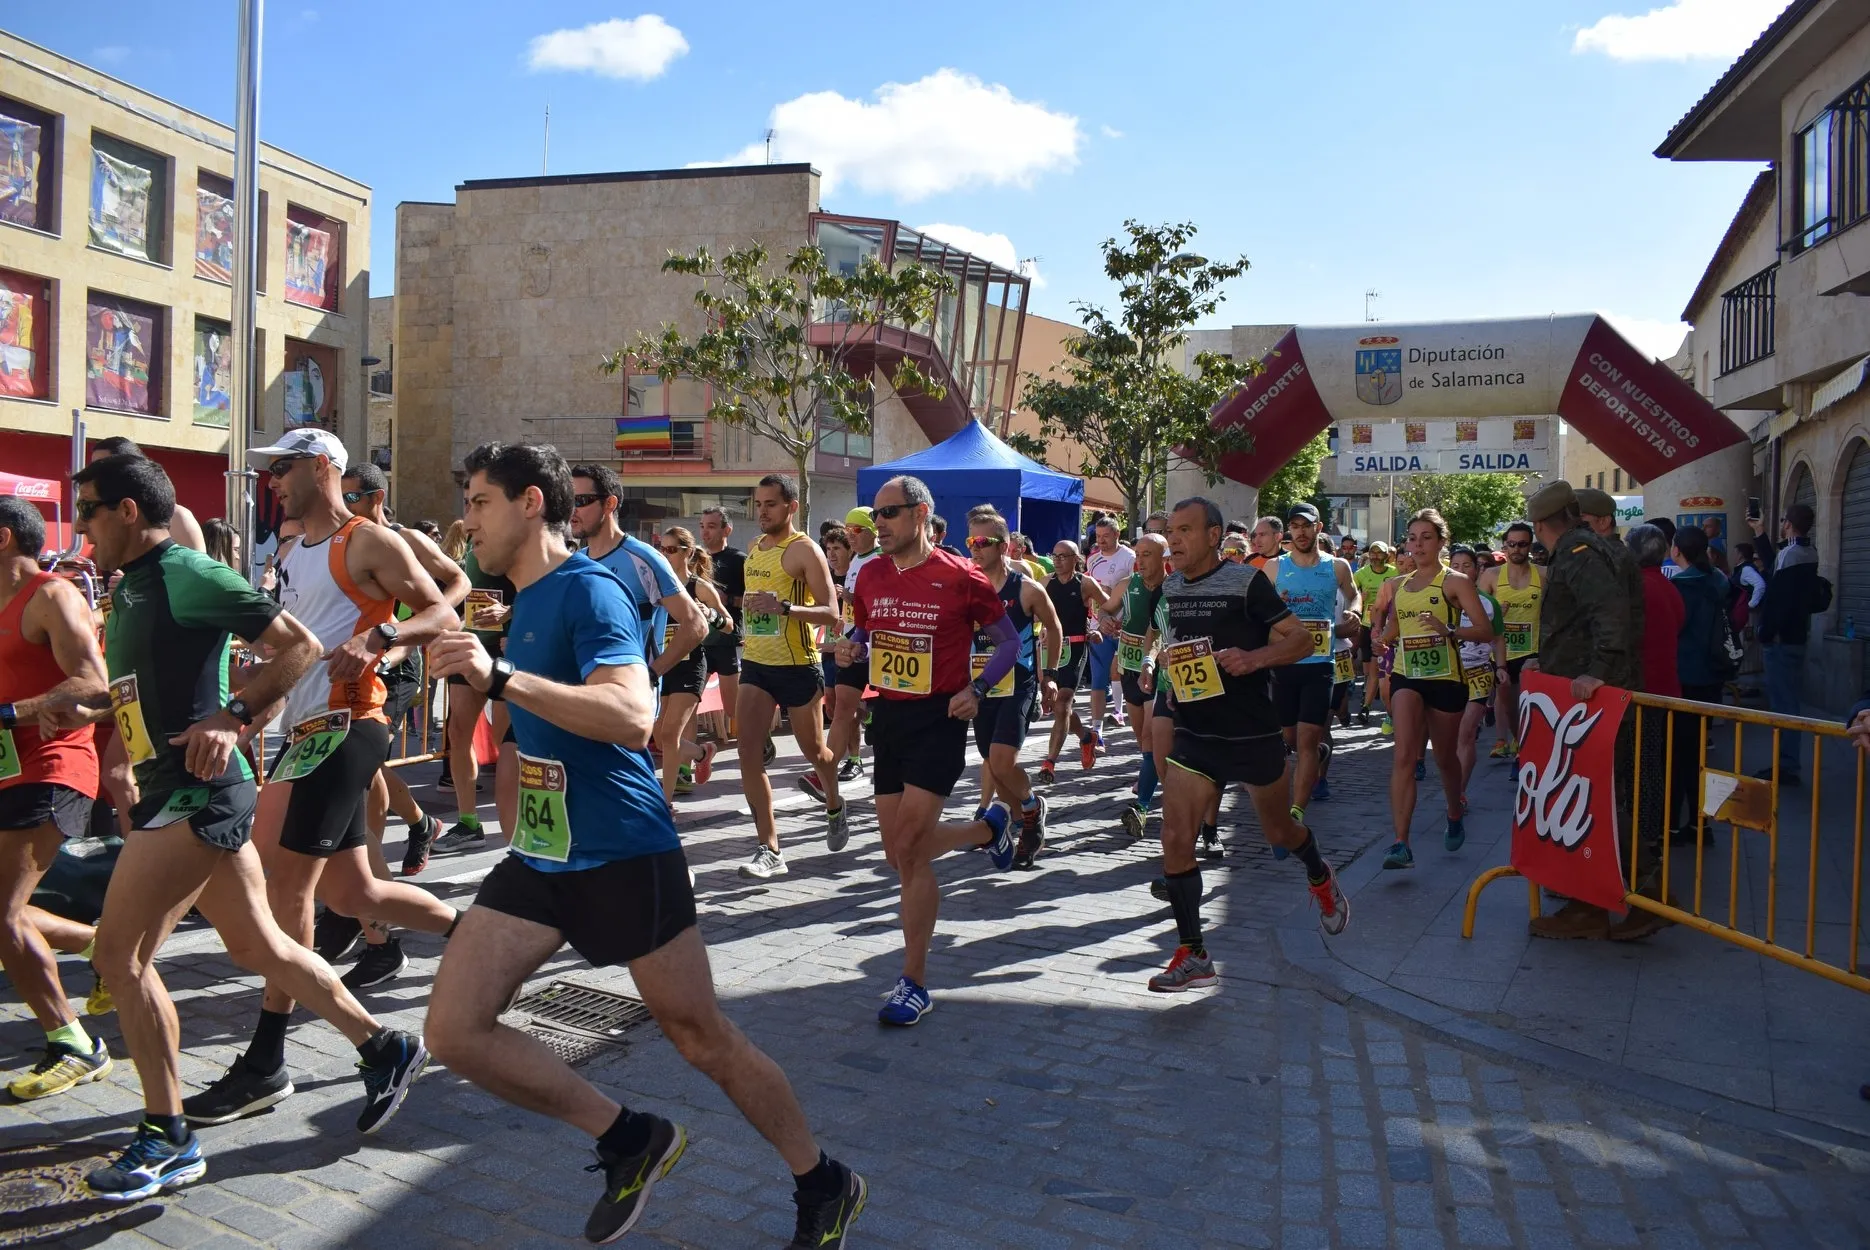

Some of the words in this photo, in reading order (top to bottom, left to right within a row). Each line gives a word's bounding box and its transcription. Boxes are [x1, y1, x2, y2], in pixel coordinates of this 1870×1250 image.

[1408, 344, 1505, 366] Diputación
[1409, 376, 1425, 389] de
[1431, 371, 1526, 389] Salamanca
[1243, 362, 1305, 420] DEPORTE
[1589, 353, 1622, 383] CON
[1620, 379, 1700, 449] NUESTROS
[1578, 372, 1678, 460] DEPORTISTAS
[1354, 455, 1422, 472] SALIDA
[1458, 453, 1531, 470] SALIDA
[1614, 506, 1644, 521] ngle
[1199, 600, 1228, 609] TARDOR
[899, 610, 905, 618] a
[905, 610, 939, 621] correr
[906, 621, 938, 630] Santander
[887, 635, 910, 646] CROSS
[915, 640, 925, 648] 19
[1503, 632, 1526, 646] 508
[1122, 645, 1143, 662] 480
[1411, 650, 1441, 668] 439
[881, 651, 920, 678] 200
[1174, 661, 1208, 686] 125
[1469, 674, 1492, 690] 159
[290, 735, 333, 762] 494
[548, 769, 558, 780] 19
